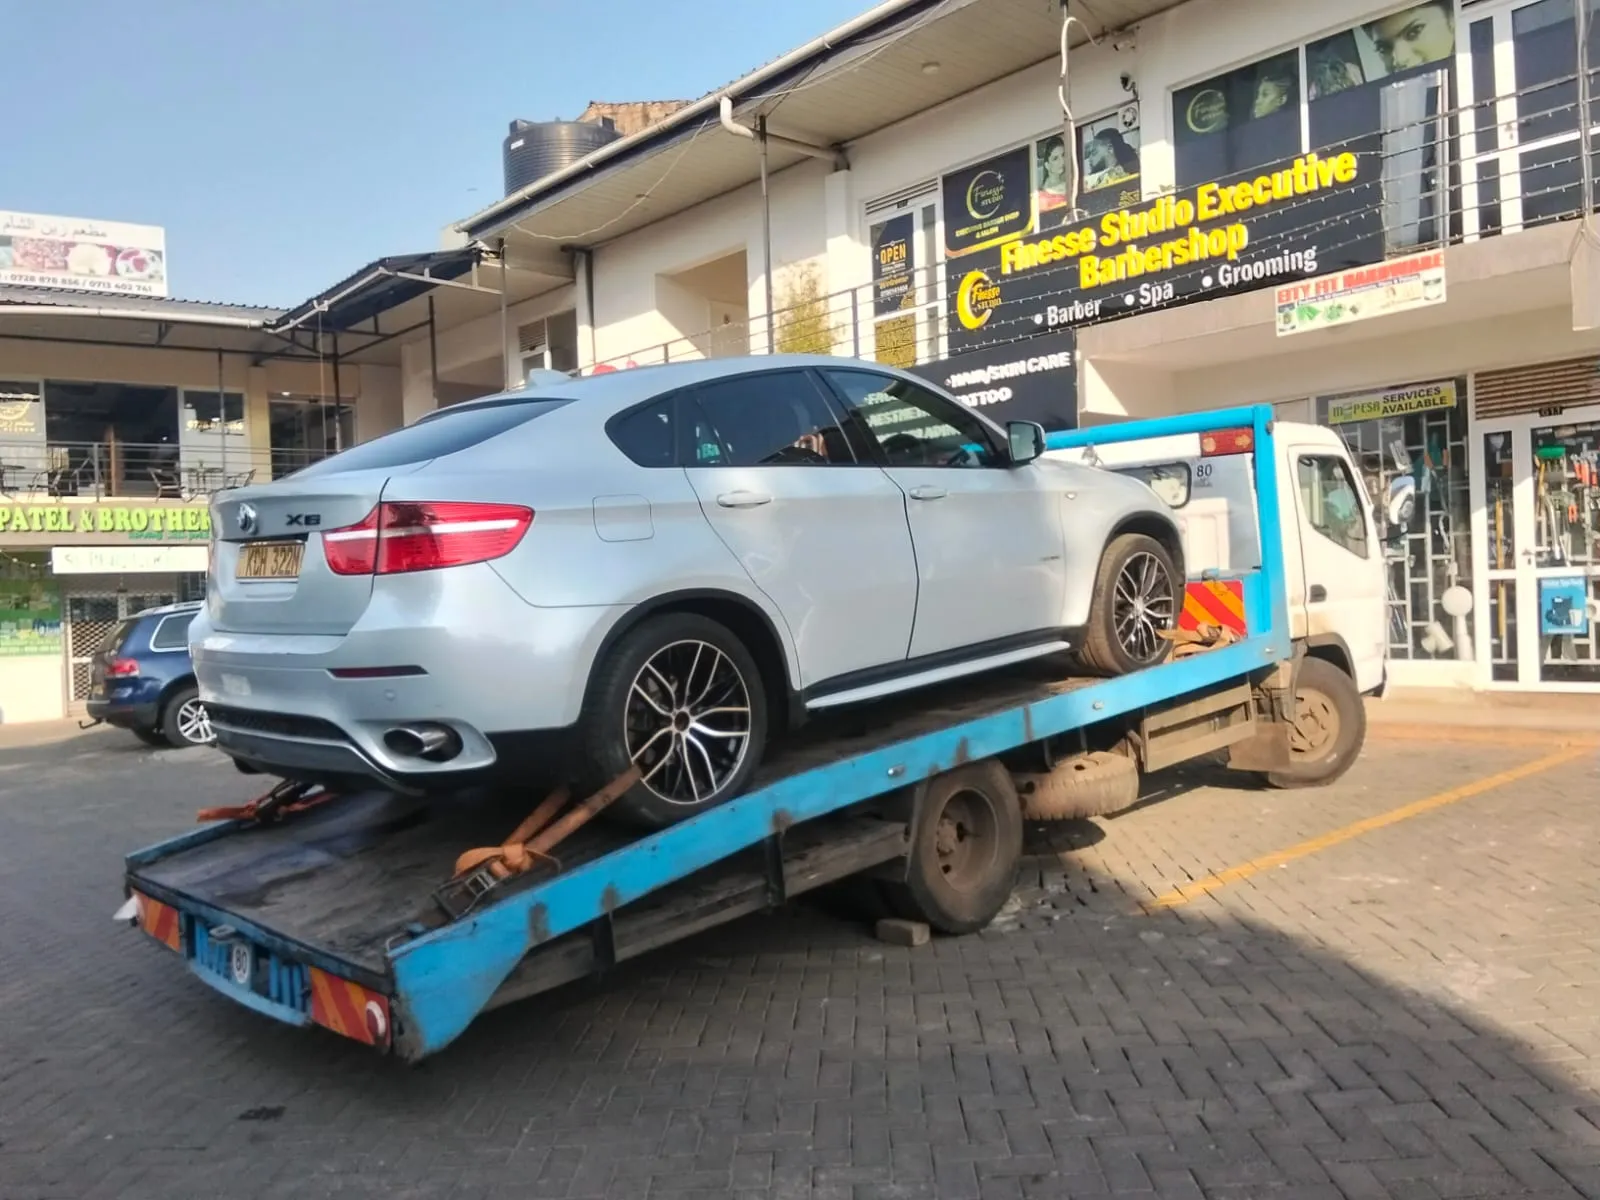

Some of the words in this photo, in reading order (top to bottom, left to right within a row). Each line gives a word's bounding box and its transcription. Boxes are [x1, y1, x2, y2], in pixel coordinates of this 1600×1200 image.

[1001, 226, 1097, 275] Finesse
[1100, 196, 1195, 247] Studio
[1197, 152, 1358, 221] Executive
[880, 243, 906, 265] OPEN
[1080, 222, 1249, 289] Barbershop
[1047, 299, 1102, 326] Barber
[1139, 281, 1174, 307] Spa
[1218, 246, 1318, 288] Grooming
[1027, 351, 1072, 373] CARE
[1381, 396, 1449, 415] AVAILABLE
[1382, 386, 1441, 404] SERVICES
[1196, 463, 1213, 478] 80
[0, 506, 76, 532] PATEL
[79, 507, 95, 532] &
[285, 513, 321, 527] X6
[235, 948, 248, 974] 80
